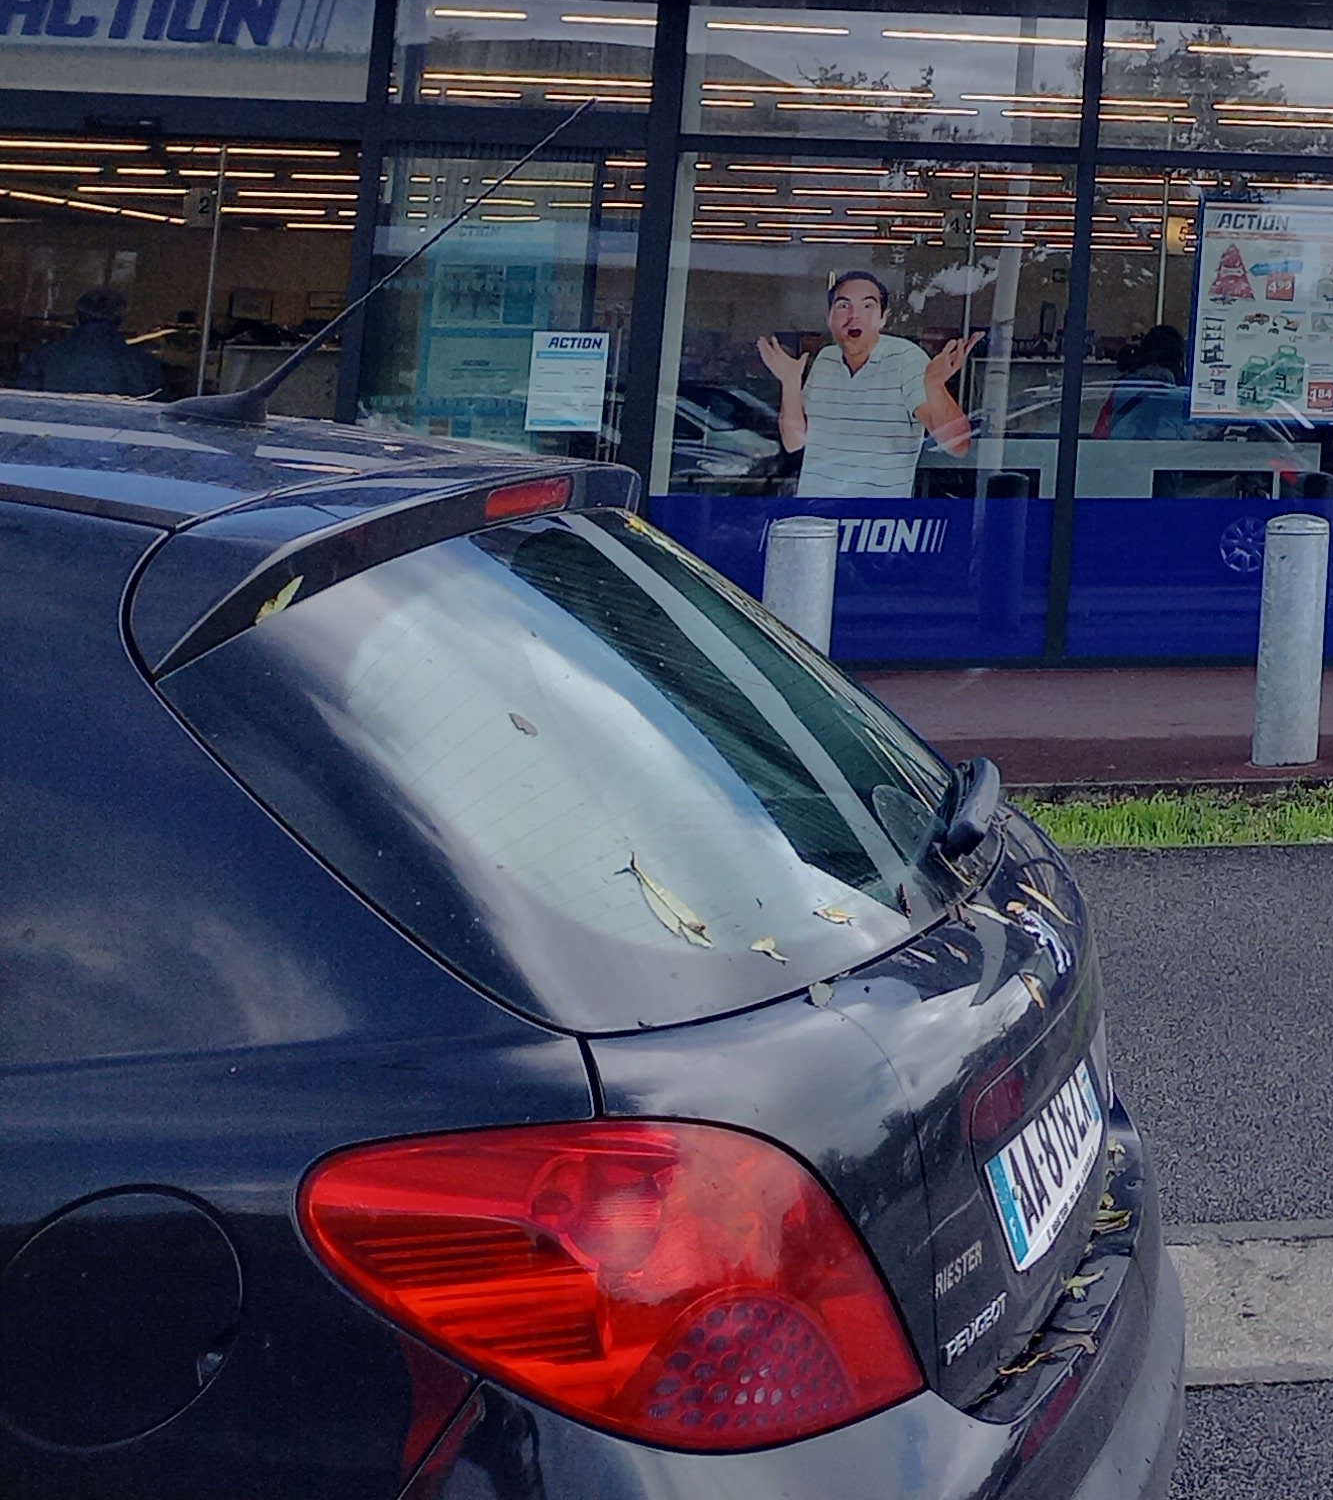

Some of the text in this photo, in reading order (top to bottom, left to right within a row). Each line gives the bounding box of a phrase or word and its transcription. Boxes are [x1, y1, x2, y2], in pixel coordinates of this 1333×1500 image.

[194, 195, 209, 214] 2
[1217, 212, 1290, 231] ACTION
[548, 336, 603, 350] ACTION
[839, 518, 923, 553] TION
[935, 1240, 983, 1300] RIESTER
[944, 1291, 1008, 1366] PEUGEOT
